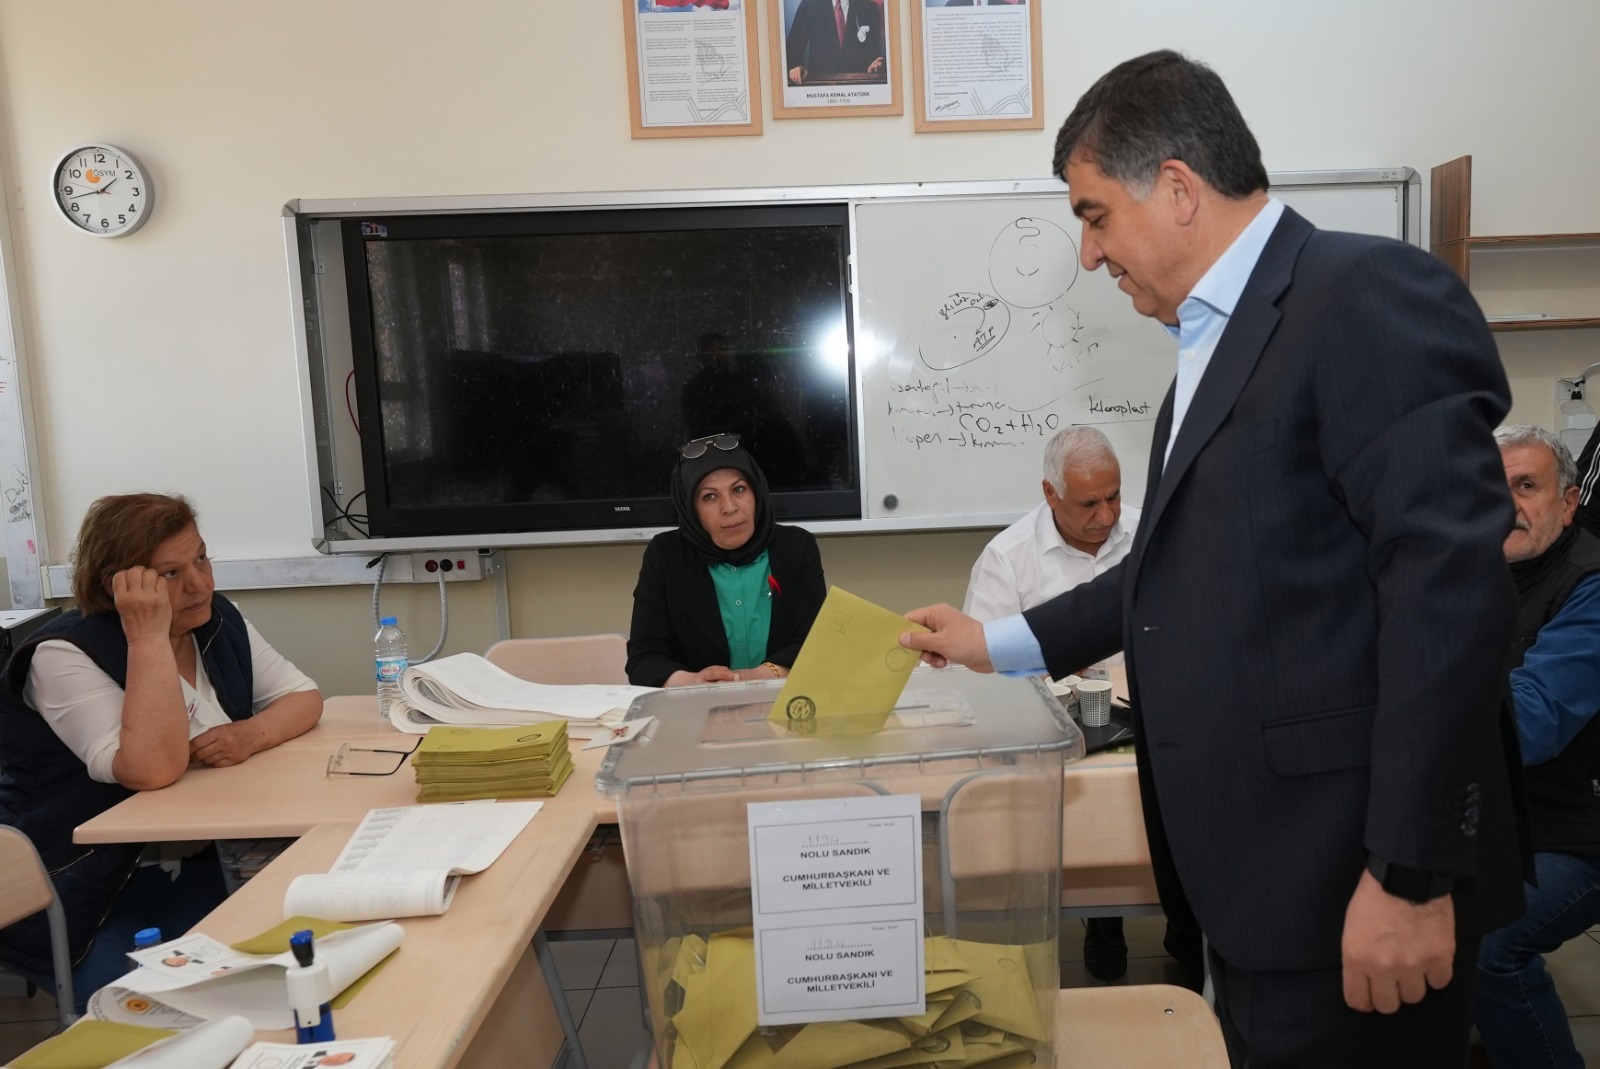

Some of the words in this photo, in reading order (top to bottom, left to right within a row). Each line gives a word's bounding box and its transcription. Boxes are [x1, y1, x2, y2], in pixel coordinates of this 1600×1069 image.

[80, 158, 87, 168] 11
[94, 154, 106, 163] 12
[69, 169, 82, 178] 10
[124, 170, 134, 180] 2
[64, 186, 74, 196] 9
[132, 188, 140, 196] 3
[70, 202, 80, 212] 8
[128, 204, 136, 212] 4
[82, 214, 91, 224] 7
[100, 218, 110, 228] 6
[118, 214, 126, 224] 5
[800, 850, 829, 859] NOLU
[832, 848, 871, 857] SANDIK
[782, 869, 874, 882] CUMHURBAŞKANI
[802, 878, 872, 890] MİLLETVEKİLİ
[805, 953, 834, 962] NOLU
[836, 950, 874, 960] SANDIK
[787, 971, 878, 984] CUMHURBAŞKANI
[806, 980, 875, 992] MİLLETVEKİLİ
